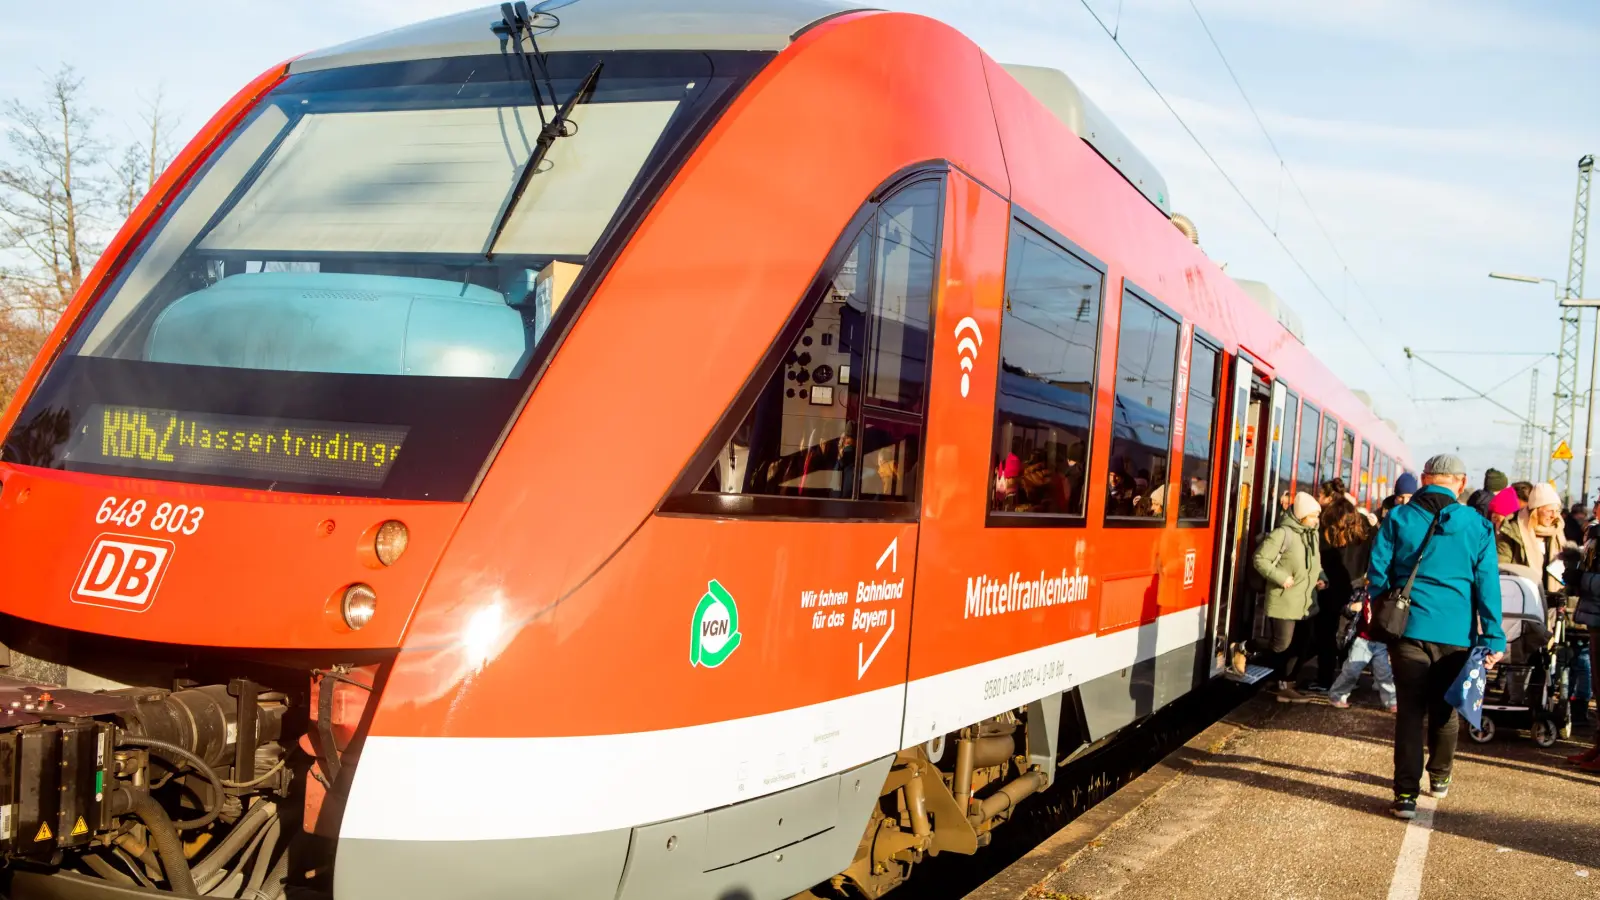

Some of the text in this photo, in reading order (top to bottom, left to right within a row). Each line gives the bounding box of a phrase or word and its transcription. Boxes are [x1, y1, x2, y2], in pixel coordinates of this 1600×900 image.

[95, 496, 205, 535] 648 803
[79, 542, 165, 602] DB
[801, 589, 848, 608] Wir fahren
[855, 578, 905, 603] Bahnland
[963, 567, 1089, 619] Mittelfrankenbahn
[702, 619, 729, 637] VGN
[812, 610, 845, 629] für das
[851, 608, 888, 633] Bayern
